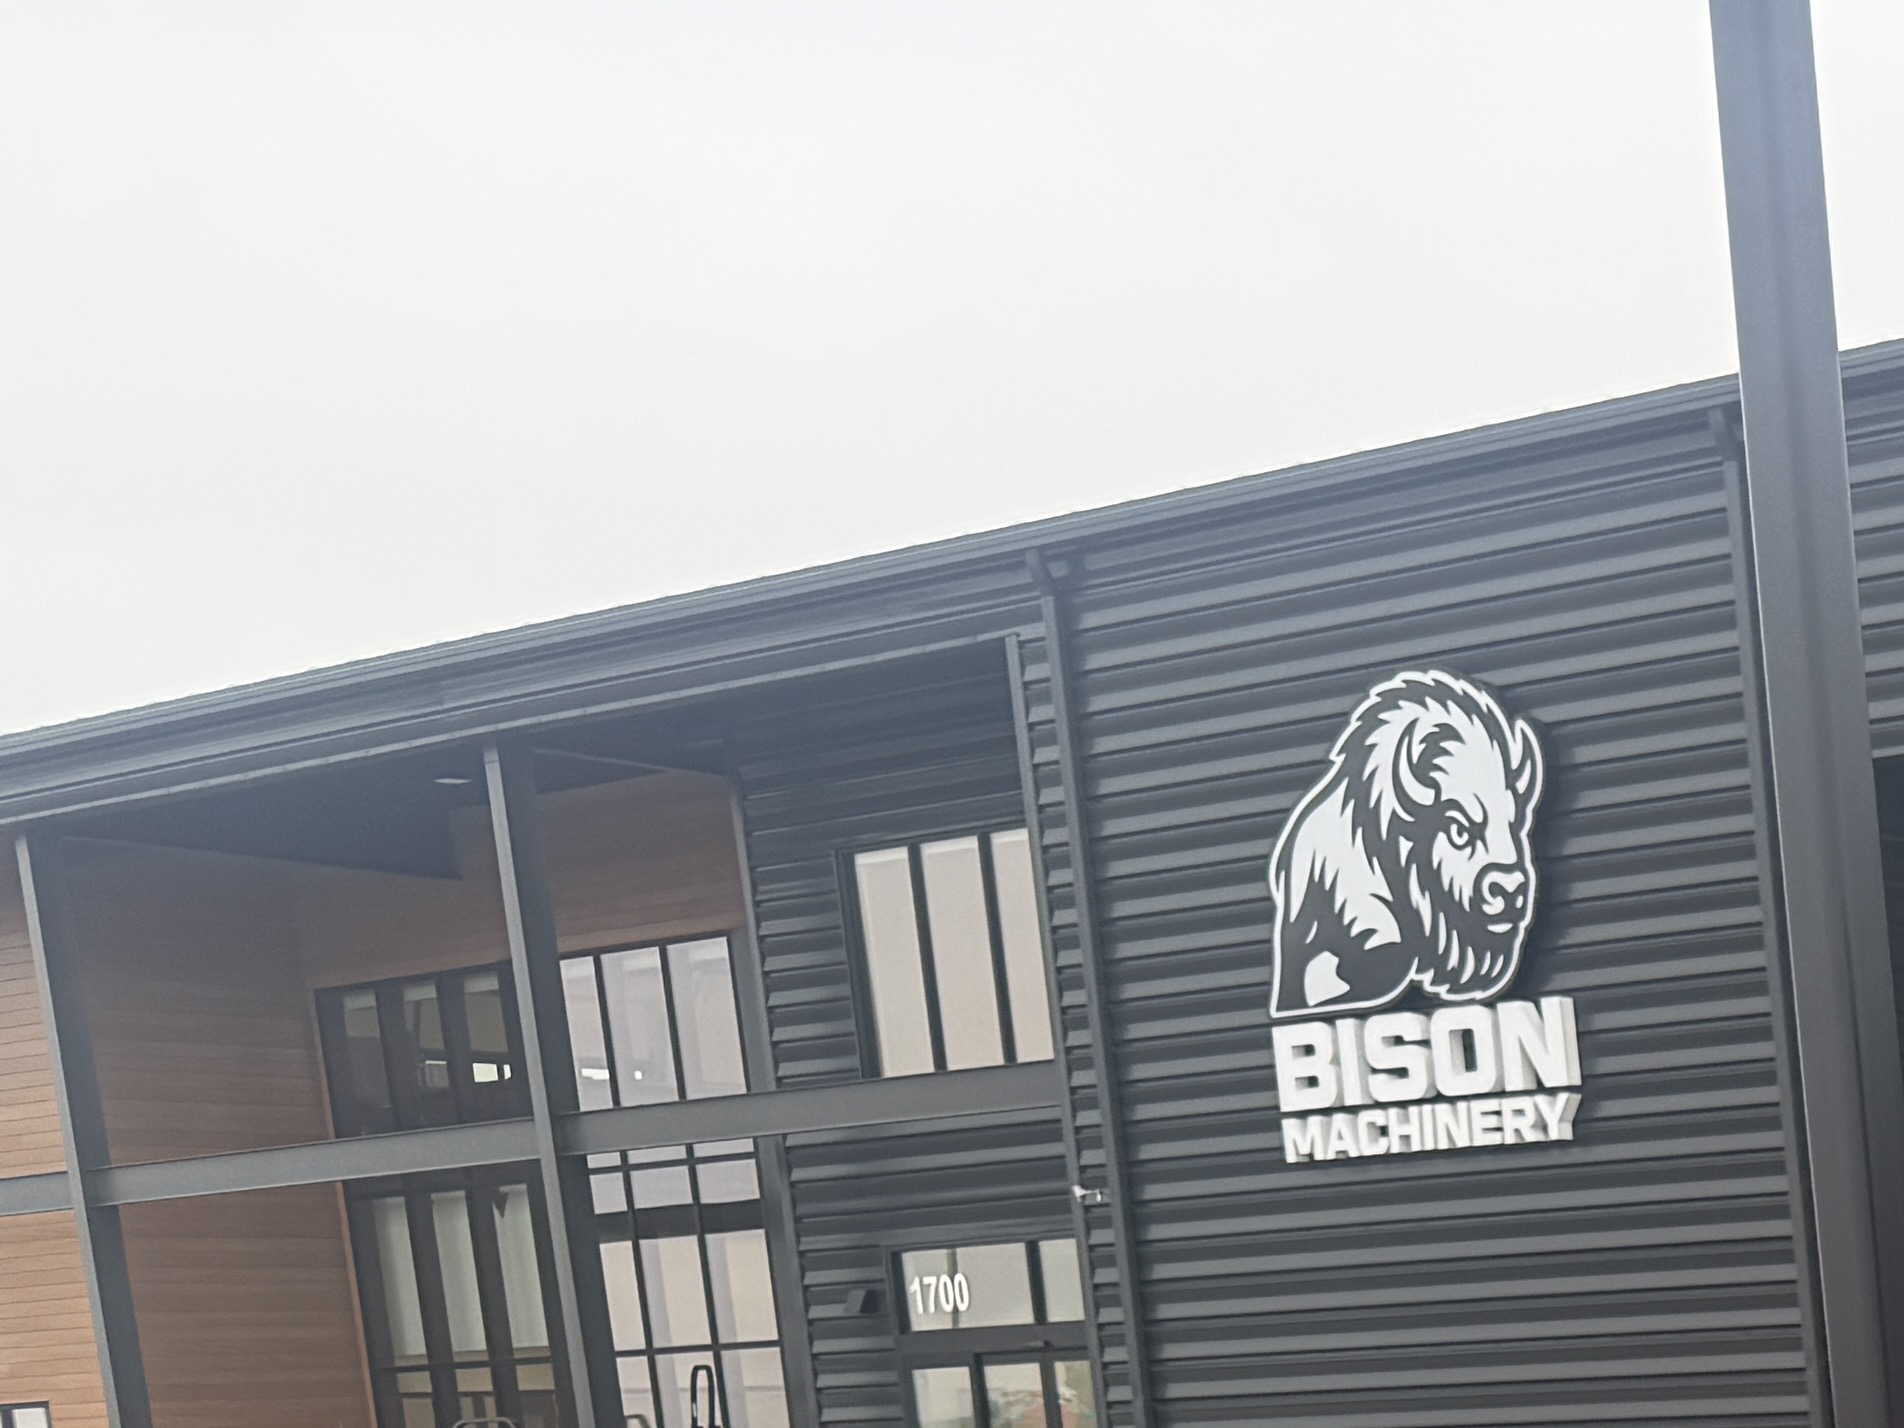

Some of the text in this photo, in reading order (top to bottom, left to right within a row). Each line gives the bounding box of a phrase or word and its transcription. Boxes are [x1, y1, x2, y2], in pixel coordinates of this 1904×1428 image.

[1272, 996, 1582, 1112] BISON
[1281, 1092, 1582, 1163] MACHINERY
[909, 1272, 970, 1314] 1700
